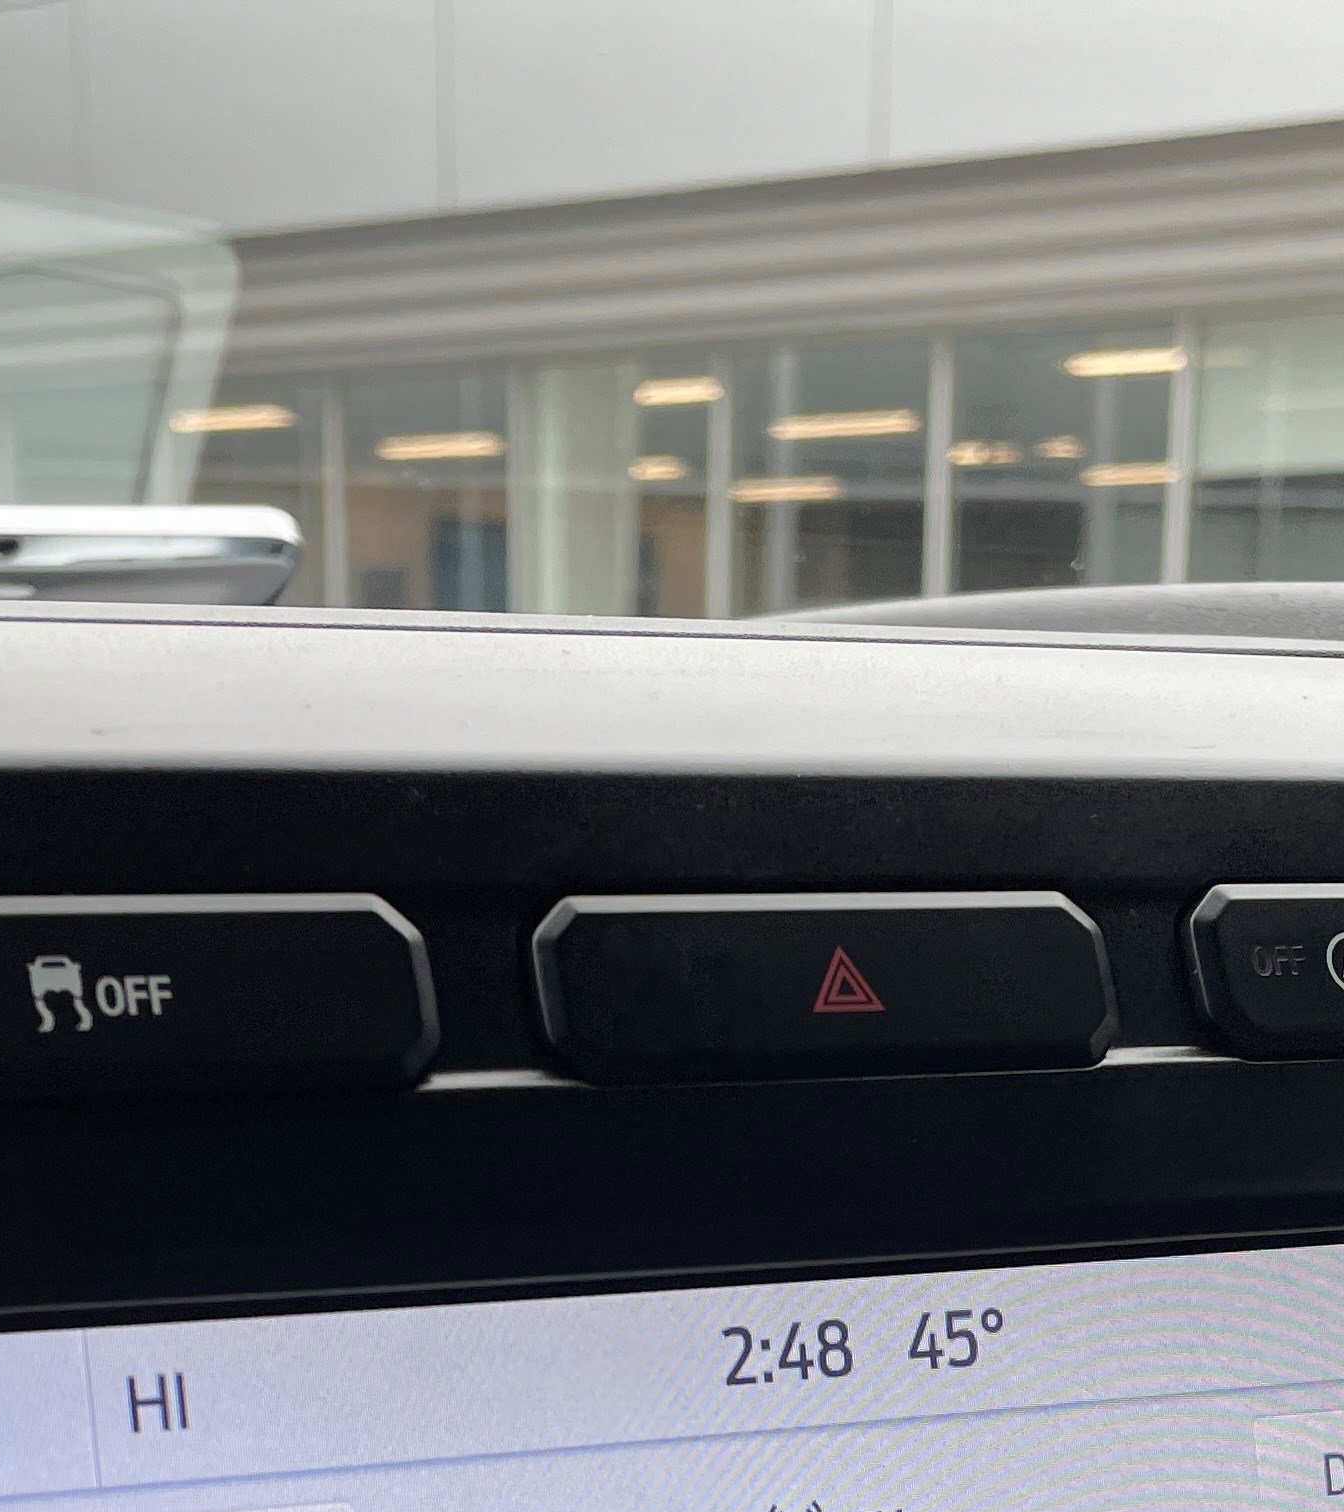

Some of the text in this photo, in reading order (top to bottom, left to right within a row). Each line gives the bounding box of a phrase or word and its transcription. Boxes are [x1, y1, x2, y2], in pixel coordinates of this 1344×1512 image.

[1254, 945, 1306, 977] OFF
[95, 974, 173, 1017] OFF
[722, 1307, 1004, 1386] 2:48 45°
[126, 1372, 189, 1433] HI
